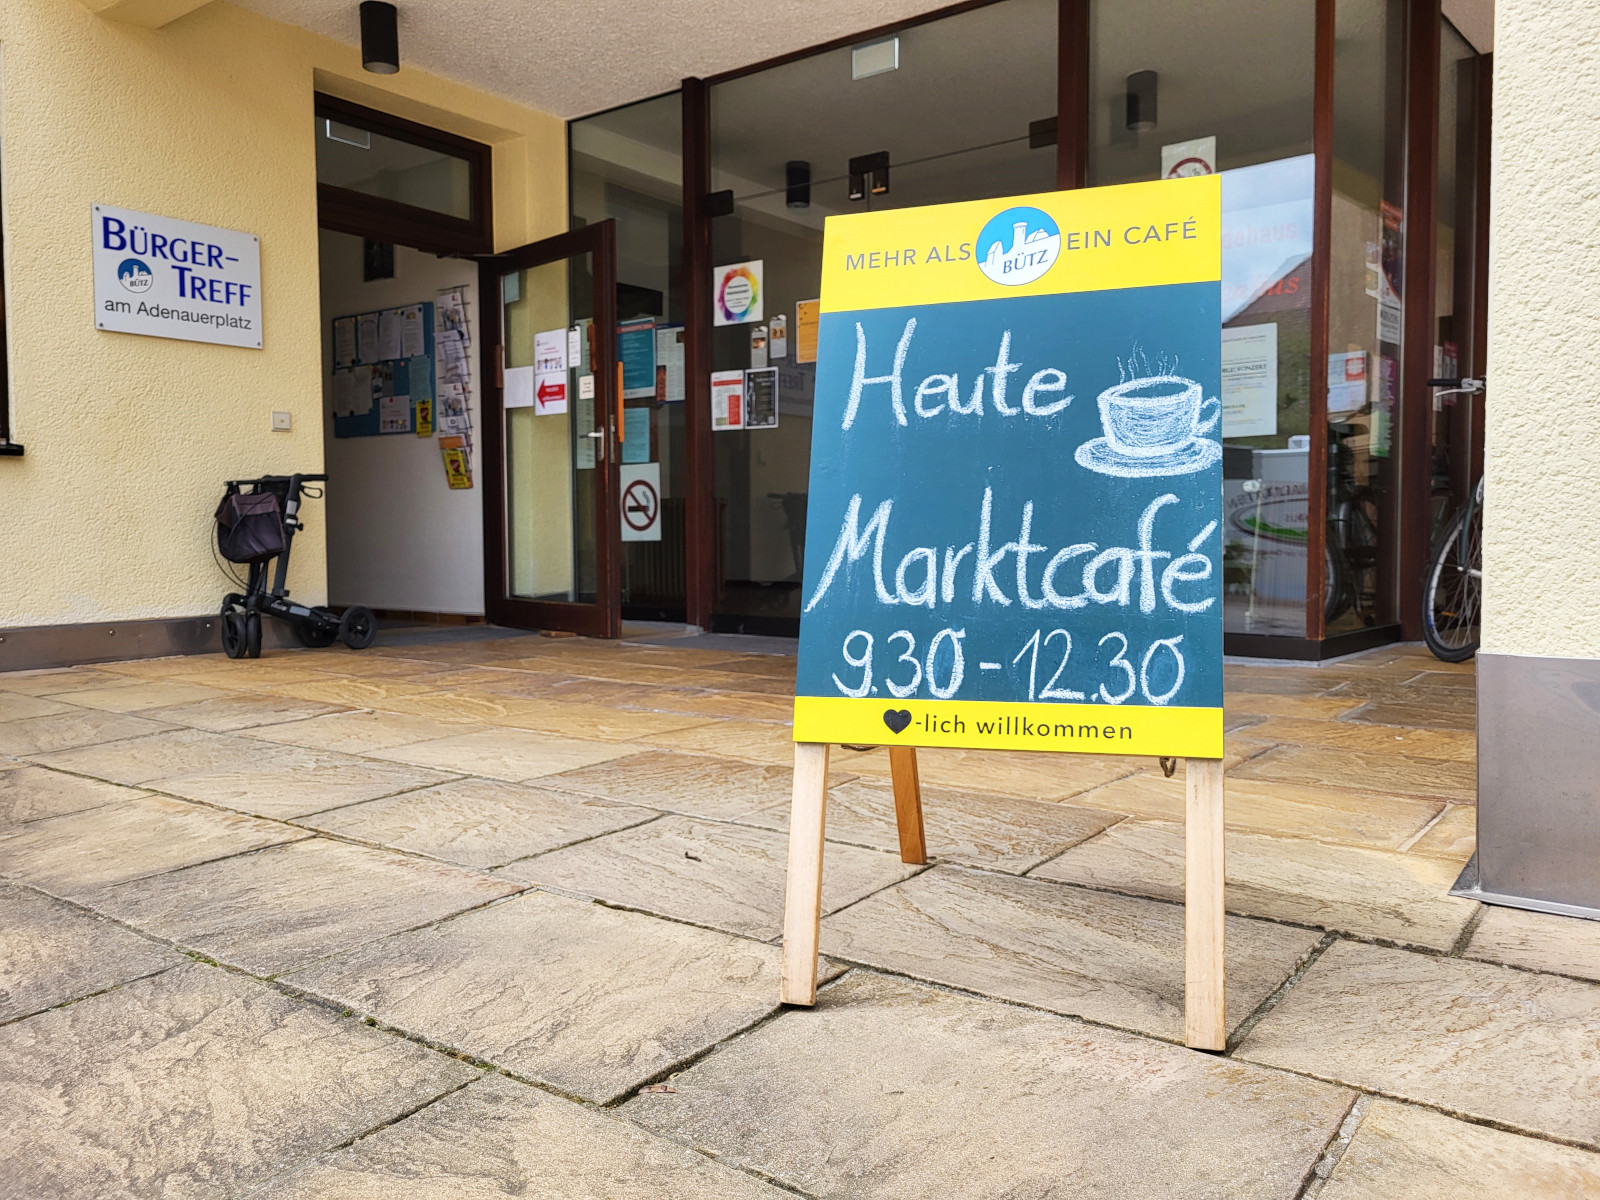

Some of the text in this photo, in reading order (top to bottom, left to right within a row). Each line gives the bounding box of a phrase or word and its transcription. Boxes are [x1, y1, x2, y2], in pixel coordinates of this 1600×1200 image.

[845, 215, 1198, 272] MEHR ALS EIN CAFÉ
[1001, 248, 1050, 275] BÜTZ
[129, 278, 149, 288] BÜTZ
[171, 265, 252, 307] TREFF
[104, 299, 252, 330] am Adenauerplatz
[841, 316, 1076, 431] Heute
[803, 486, 1219, 614] Marktcafé
[1012, 628, 1185, 706] 12.30
[976, 718, 1133, 740] willkommen
